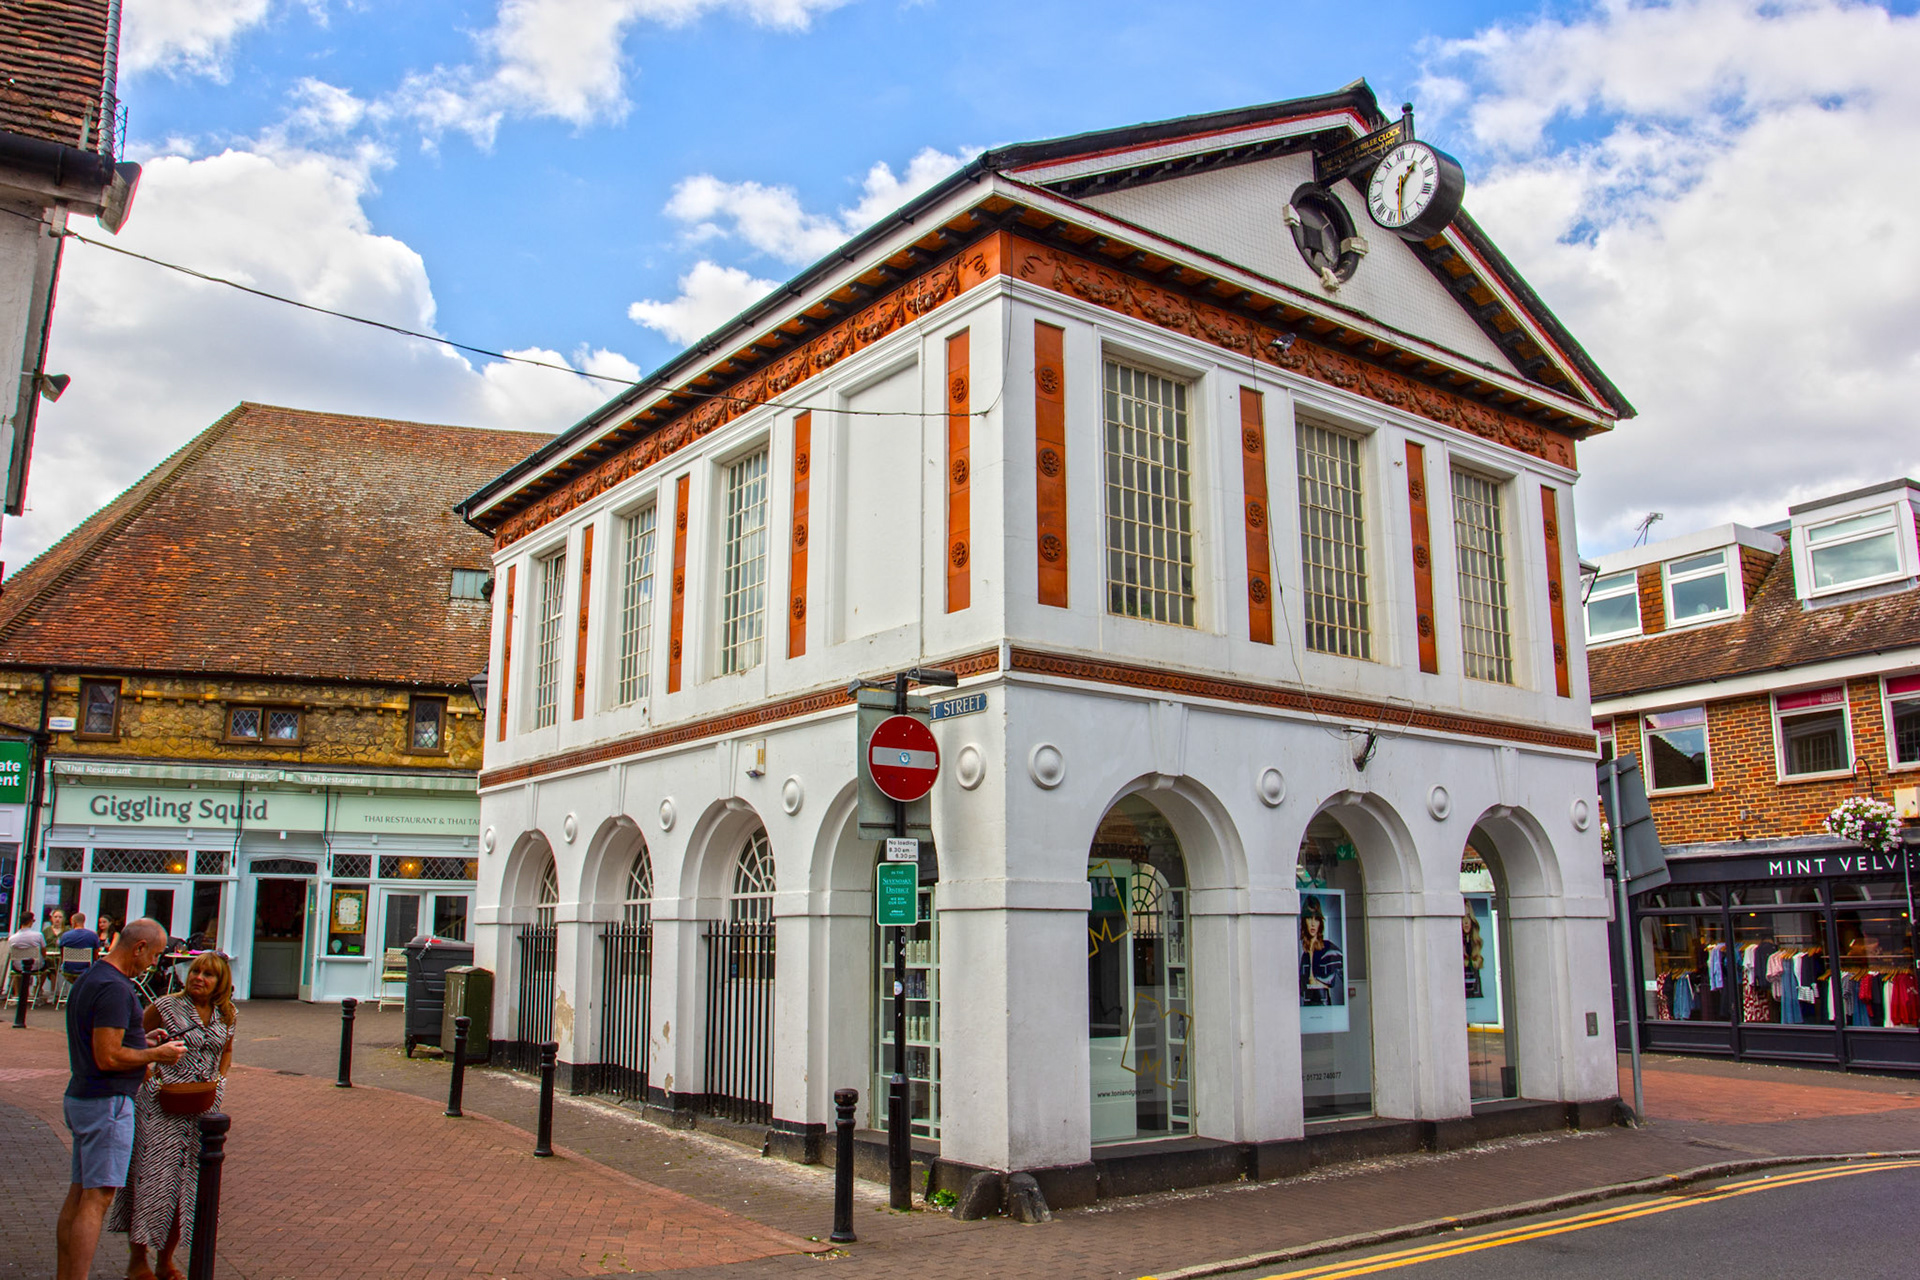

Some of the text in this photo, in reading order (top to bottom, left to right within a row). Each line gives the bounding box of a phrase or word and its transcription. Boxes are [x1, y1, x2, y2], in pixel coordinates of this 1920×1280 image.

[1377, 126, 1401, 143] CLOCK
[943, 695, 981, 717] STREET
[67, 764, 132, 775] Thai Restaurant
[227, 770, 269, 781] Thai Tapas
[303, 774, 363, 785] Thai Restaurant
[90, 795, 268, 824] Giggling Squid
[364, 815, 384, 823] THAI
[385, 816, 437, 825] RESTAURANT
[438, 817, 445, 825] &
[1769, 858, 1826, 876] MINT
